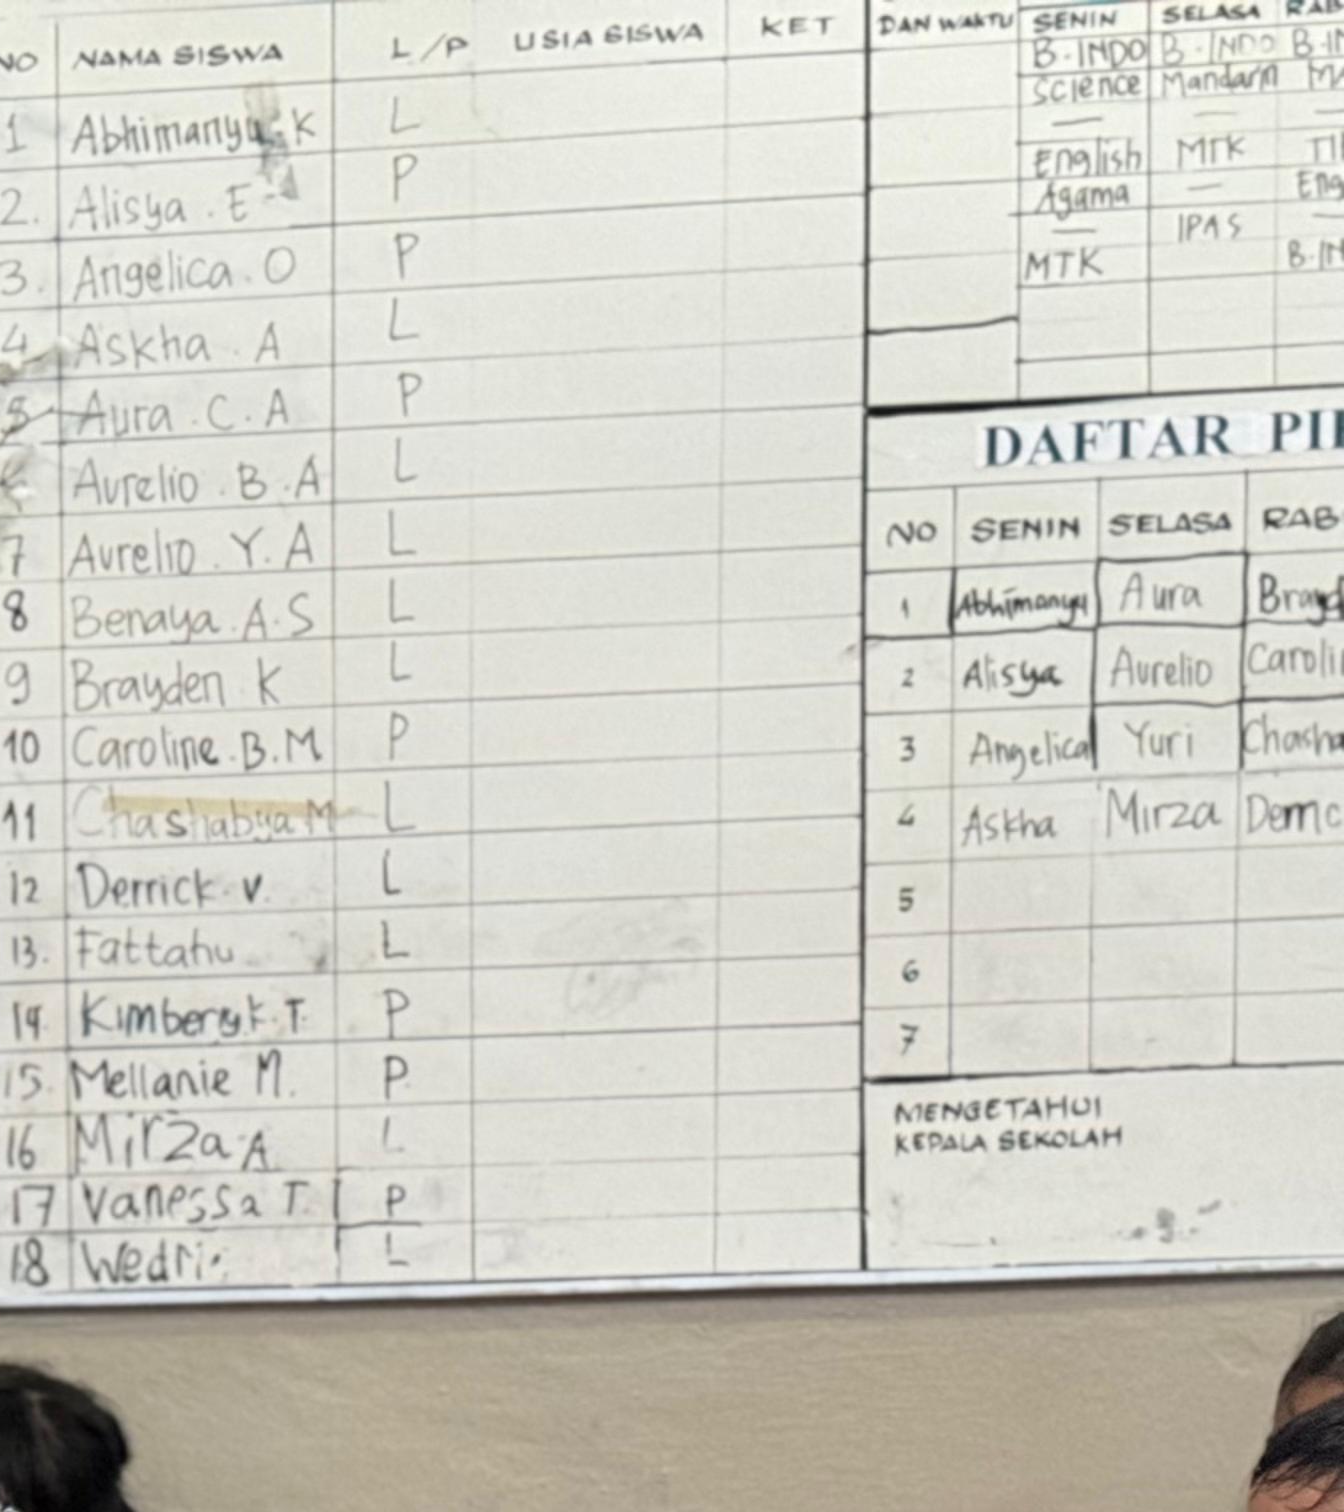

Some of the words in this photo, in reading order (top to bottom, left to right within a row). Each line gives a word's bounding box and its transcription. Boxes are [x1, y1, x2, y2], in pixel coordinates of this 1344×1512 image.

[878, 15, 930, 35] DAN
[940, 13, 1013, 32] WAKTU
[1032, 11, 1118, 33] SENIN
[1161, 5, 1260, 25] SELASA
[72, 48, 161, 70] NAMA
[173, 43, 283, 67] SISWA
[514, 30, 593, 52] USIA
[604, 21, 704, 45] SISWA
[761, 16, 836, 38] KET
[1033, 71, 1141, 106] Science
[1161, 63, 1279, 99] Mandarin
[6, 113, 27, 153] 1
[391, 96, 421, 135] L
[393, 153, 418, 201] P
[1035, 137, 1141, 178] English
[1178, 135, 1246, 166] MTK
[1035, 181, 1129, 222] Agama
[1178, 213, 1242, 243] IPAS
[394, 231, 419, 279] P
[1024, 247, 1104, 282] MTK
[389, 297, 419, 341] L
[398, 372, 423, 417] P
[392, 437, 419, 482] L
[985, 414, 1232, 467] DAFTAR
[2, 534, 25, 577] 7
[389, 509, 418, 556] L
[886, 521, 937, 548] NO
[970, 517, 1081, 543] SENIN
[1108, 512, 1233, 537] SELASA
[1263, 506, 1344, 531] RAB
[2, 589, 28, 631] 8
[389, 577, 416, 624] L
[900, 599, 909, 618] 1
[1120, 571, 1202, 615] Aura
[4, 660, 30, 706] 9
[71, 658, 226, 713] Brayden
[390, 640, 413, 681] L
[902, 668, 914, 687] 2
[963, 655, 1064, 697] Alisya
[1111, 646, 1213, 689] Aurelio
[1248, 642, 1344, 676] Caroli
[2, 729, 40, 764] 10
[388, 712, 410, 761] P
[899, 737, 915, 762] 3
[969, 732, 1091, 780] Angelica
[1123, 720, 1195, 761] Yuri
[2, 799, 35, 842] 11
[383, 779, 416, 831] L
[897, 805, 915, 826] 4
[961, 804, 1057, 848] Askha
[1106, 786, 1222, 839] Mirza
[11, 871, 39, 905] 12
[382, 848, 403, 896] L
[898, 887, 915, 913] 5
[381, 919, 411, 961] L
[901, 959, 920, 984] 6
[384, 989, 411, 1041] P
[900, 1024, 919, 1057] 7
[70, 1057, 233, 1100] Mellanie
[894, 1096, 1103, 1125] MENGETAHUI
[6, 1123, 36, 1171] 16
[382, 1116, 405, 1153] L
[894, 1130, 987, 1156] KEPALA
[999, 1126, 1124, 1152] SEKOLAH
[13, 1183, 55, 1227] 17
[83, 1182, 262, 1226] Vanessa
[386, 1184, 407, 1219] P
[13, 1237, 50, 1288] 18
[386, 1232, 410, 1267] L
